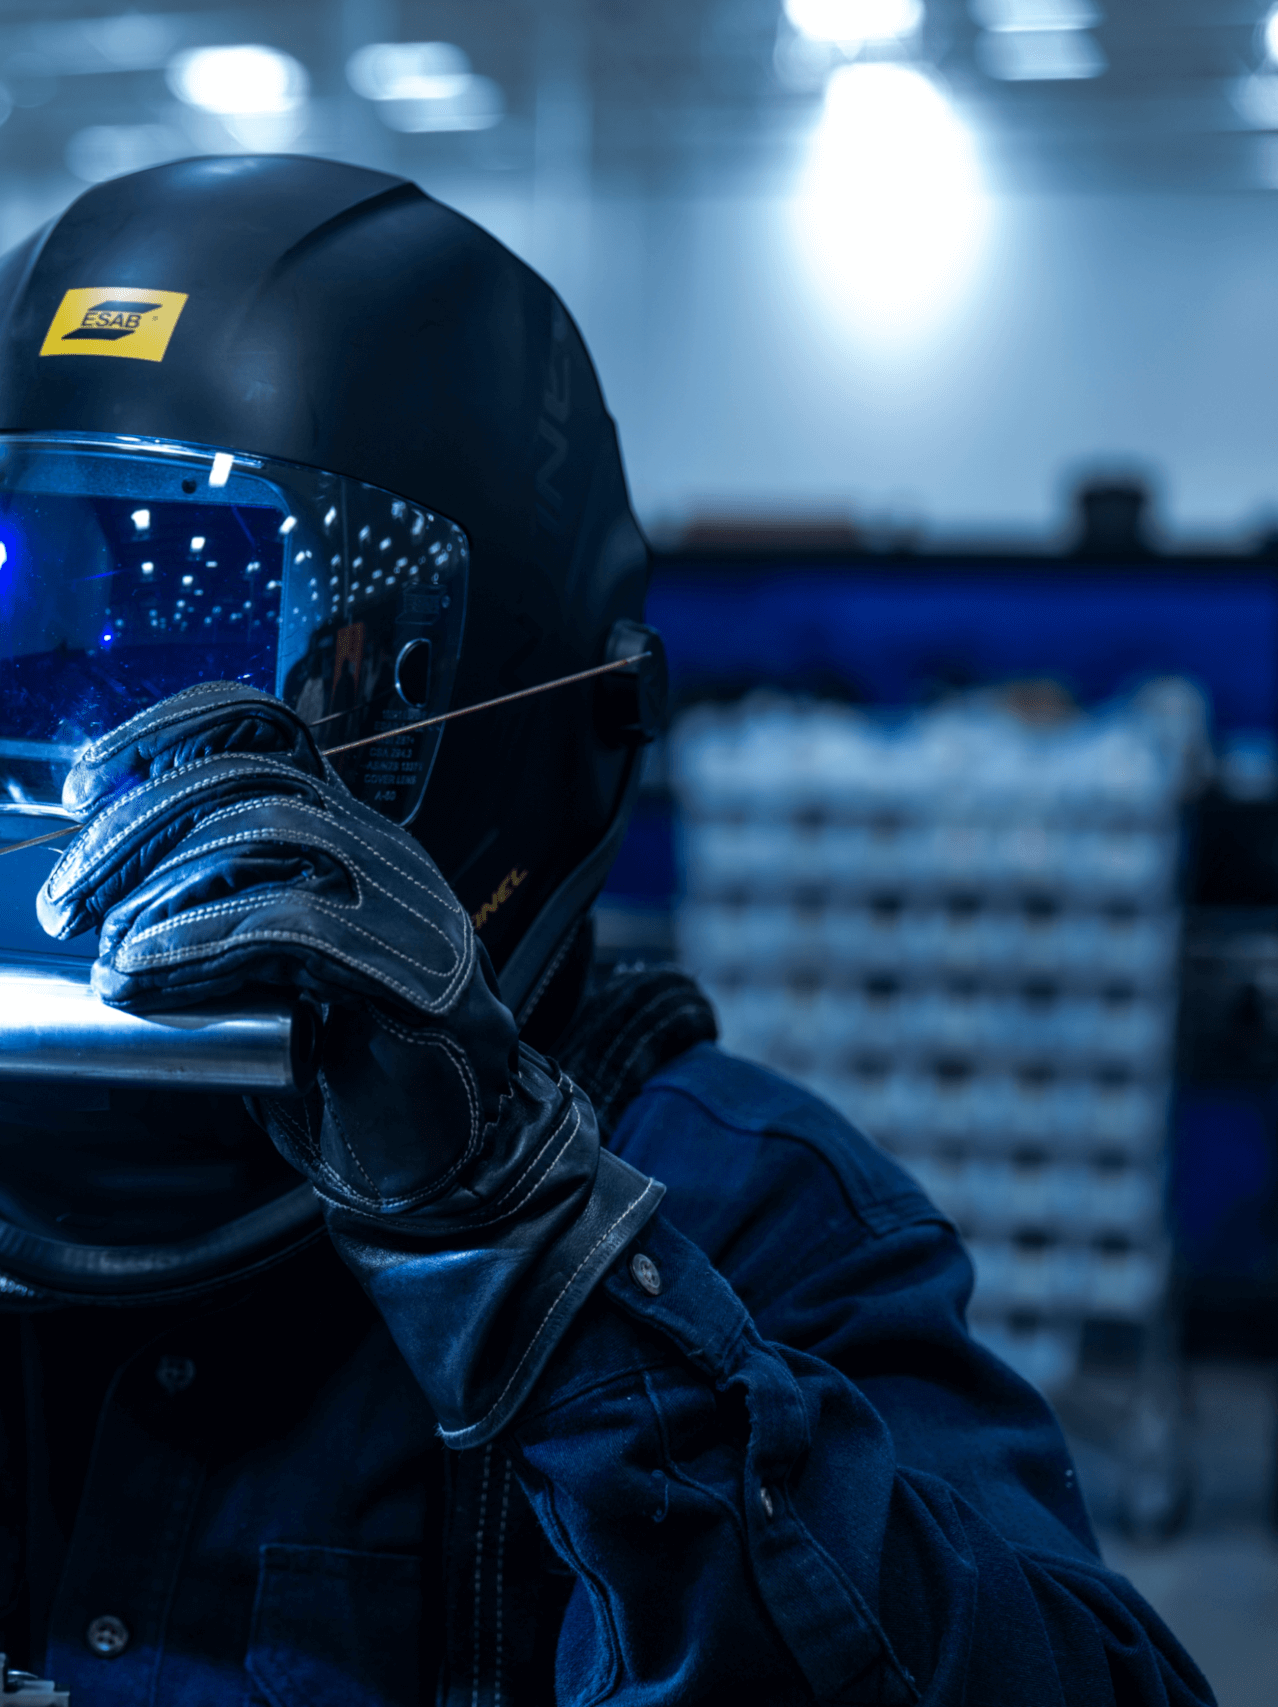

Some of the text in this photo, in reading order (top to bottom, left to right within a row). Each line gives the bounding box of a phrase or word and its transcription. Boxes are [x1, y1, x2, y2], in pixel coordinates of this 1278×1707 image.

[82, 311, 141, 329] ESAB
[363, 773, 417, 785] COVER LENS
